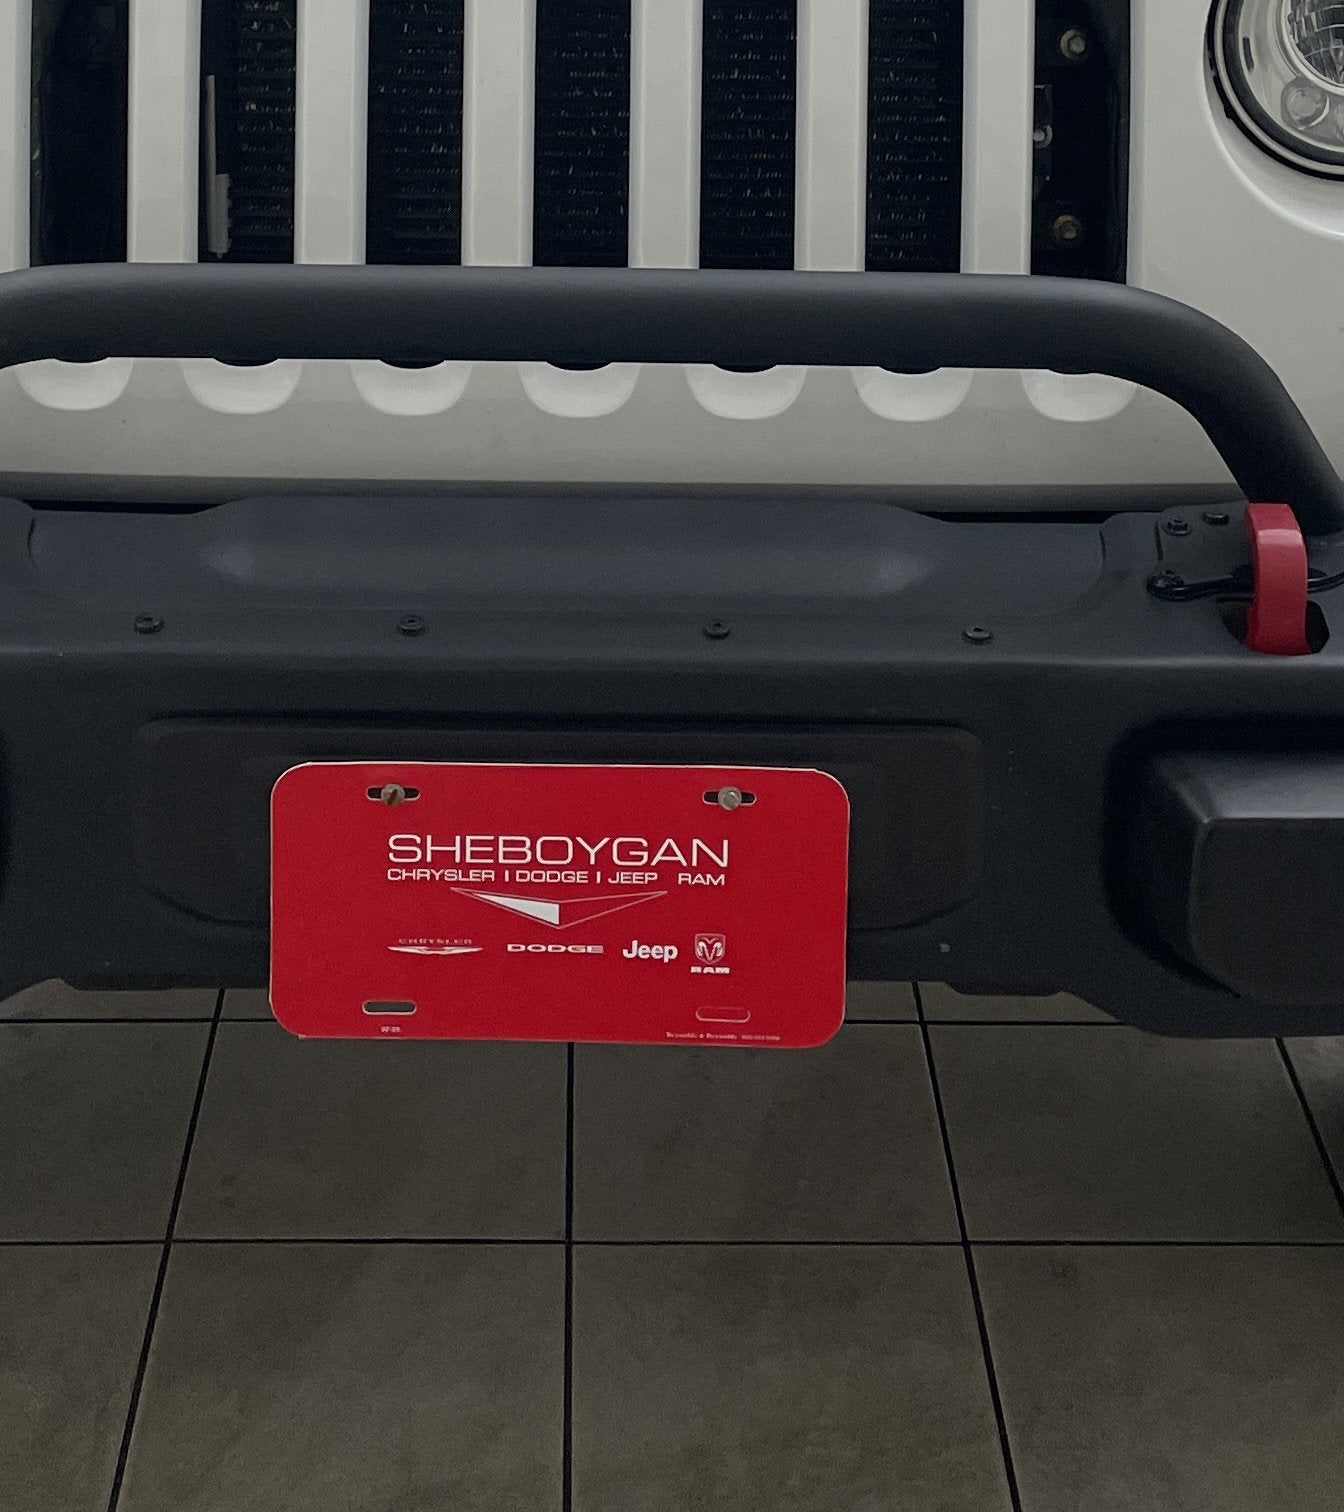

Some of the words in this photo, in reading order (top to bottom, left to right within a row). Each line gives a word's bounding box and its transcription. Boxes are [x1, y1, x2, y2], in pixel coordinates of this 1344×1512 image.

[388, 834, 729, 868] SHEBOYGAN
[387, 868, 495, 882] CHRYSLER
[515, 870, 589, 884] DODGE
[608, 871, 658, 885] JEEP
[677, 872, 726, 886] RAM
[507, 943, 604, 954] DODGE
[622, 940, 678, 963] Jeep
[690, 966, 731, 974] RAM
